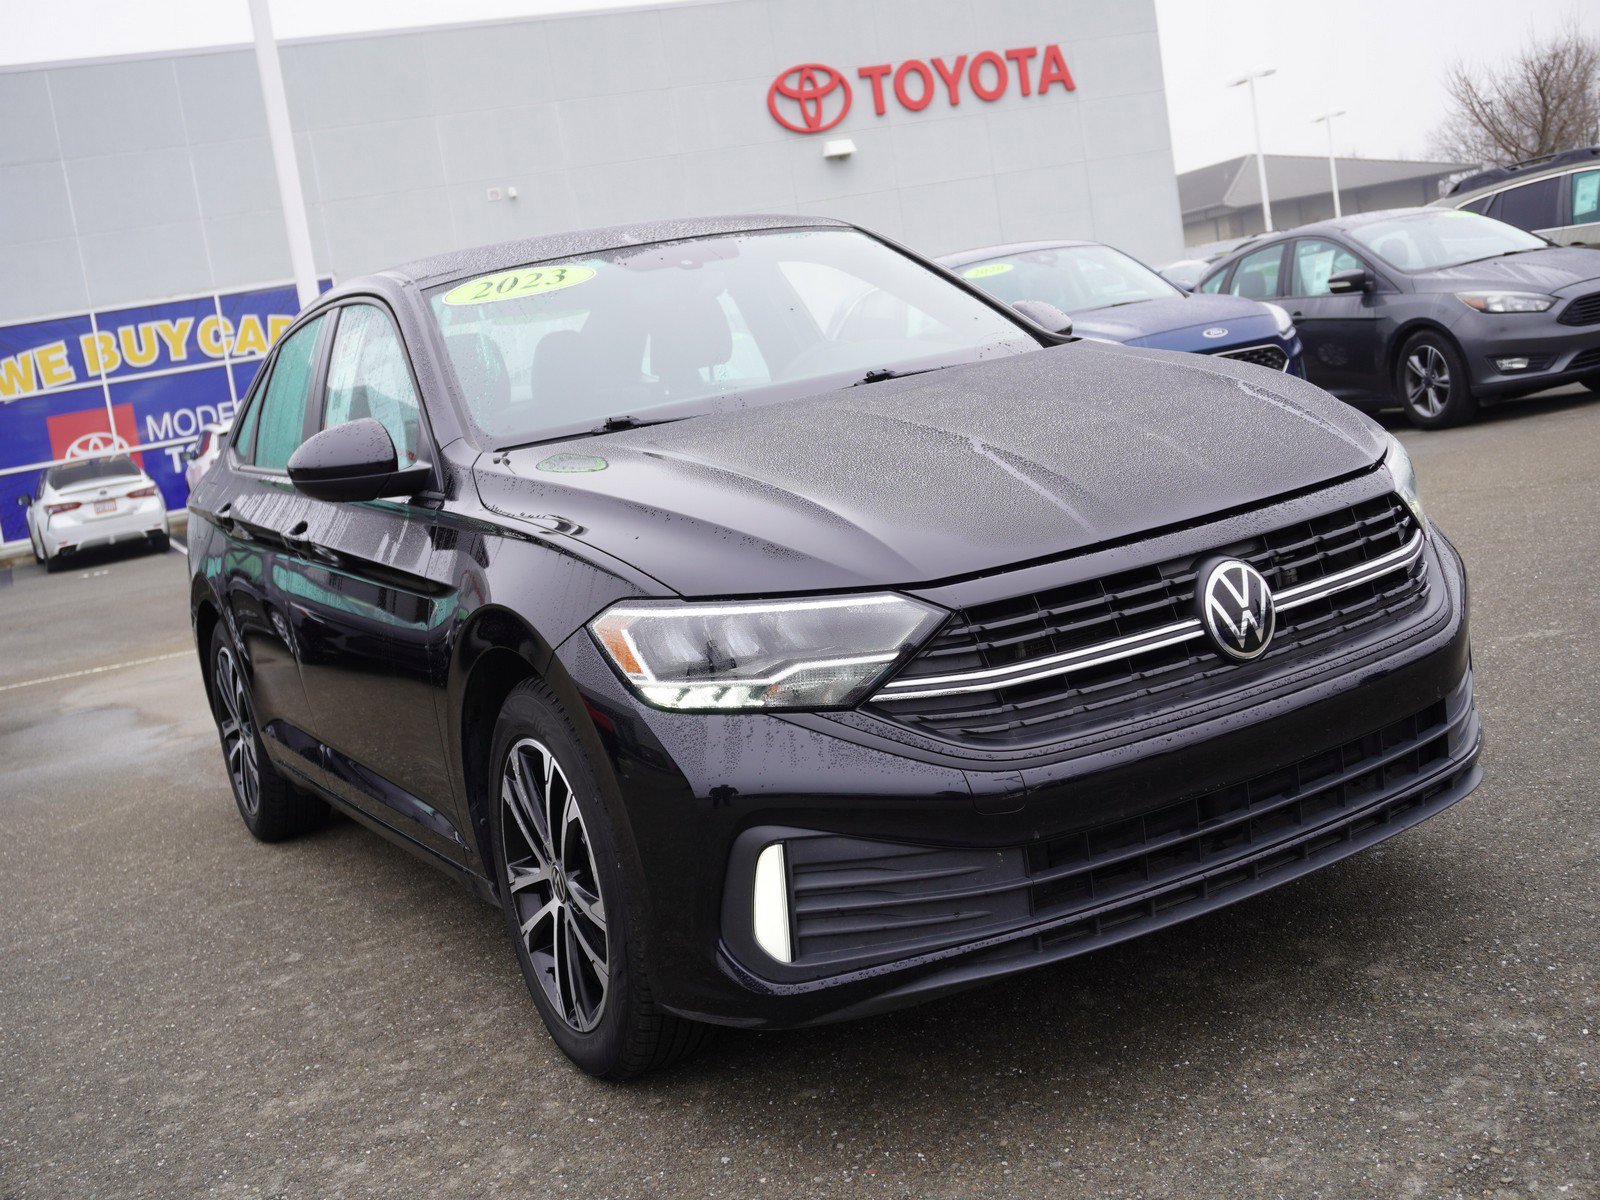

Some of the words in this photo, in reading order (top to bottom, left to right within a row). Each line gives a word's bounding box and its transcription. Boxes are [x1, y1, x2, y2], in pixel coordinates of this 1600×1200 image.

[858, 44, 1076, 115] TOYOTA
[470, 269, 567, 300] 2023
[0, 339, 77, 403] WE
[79, 316, 195, 377] BUY
[146, 401, 236, 442] MODE
